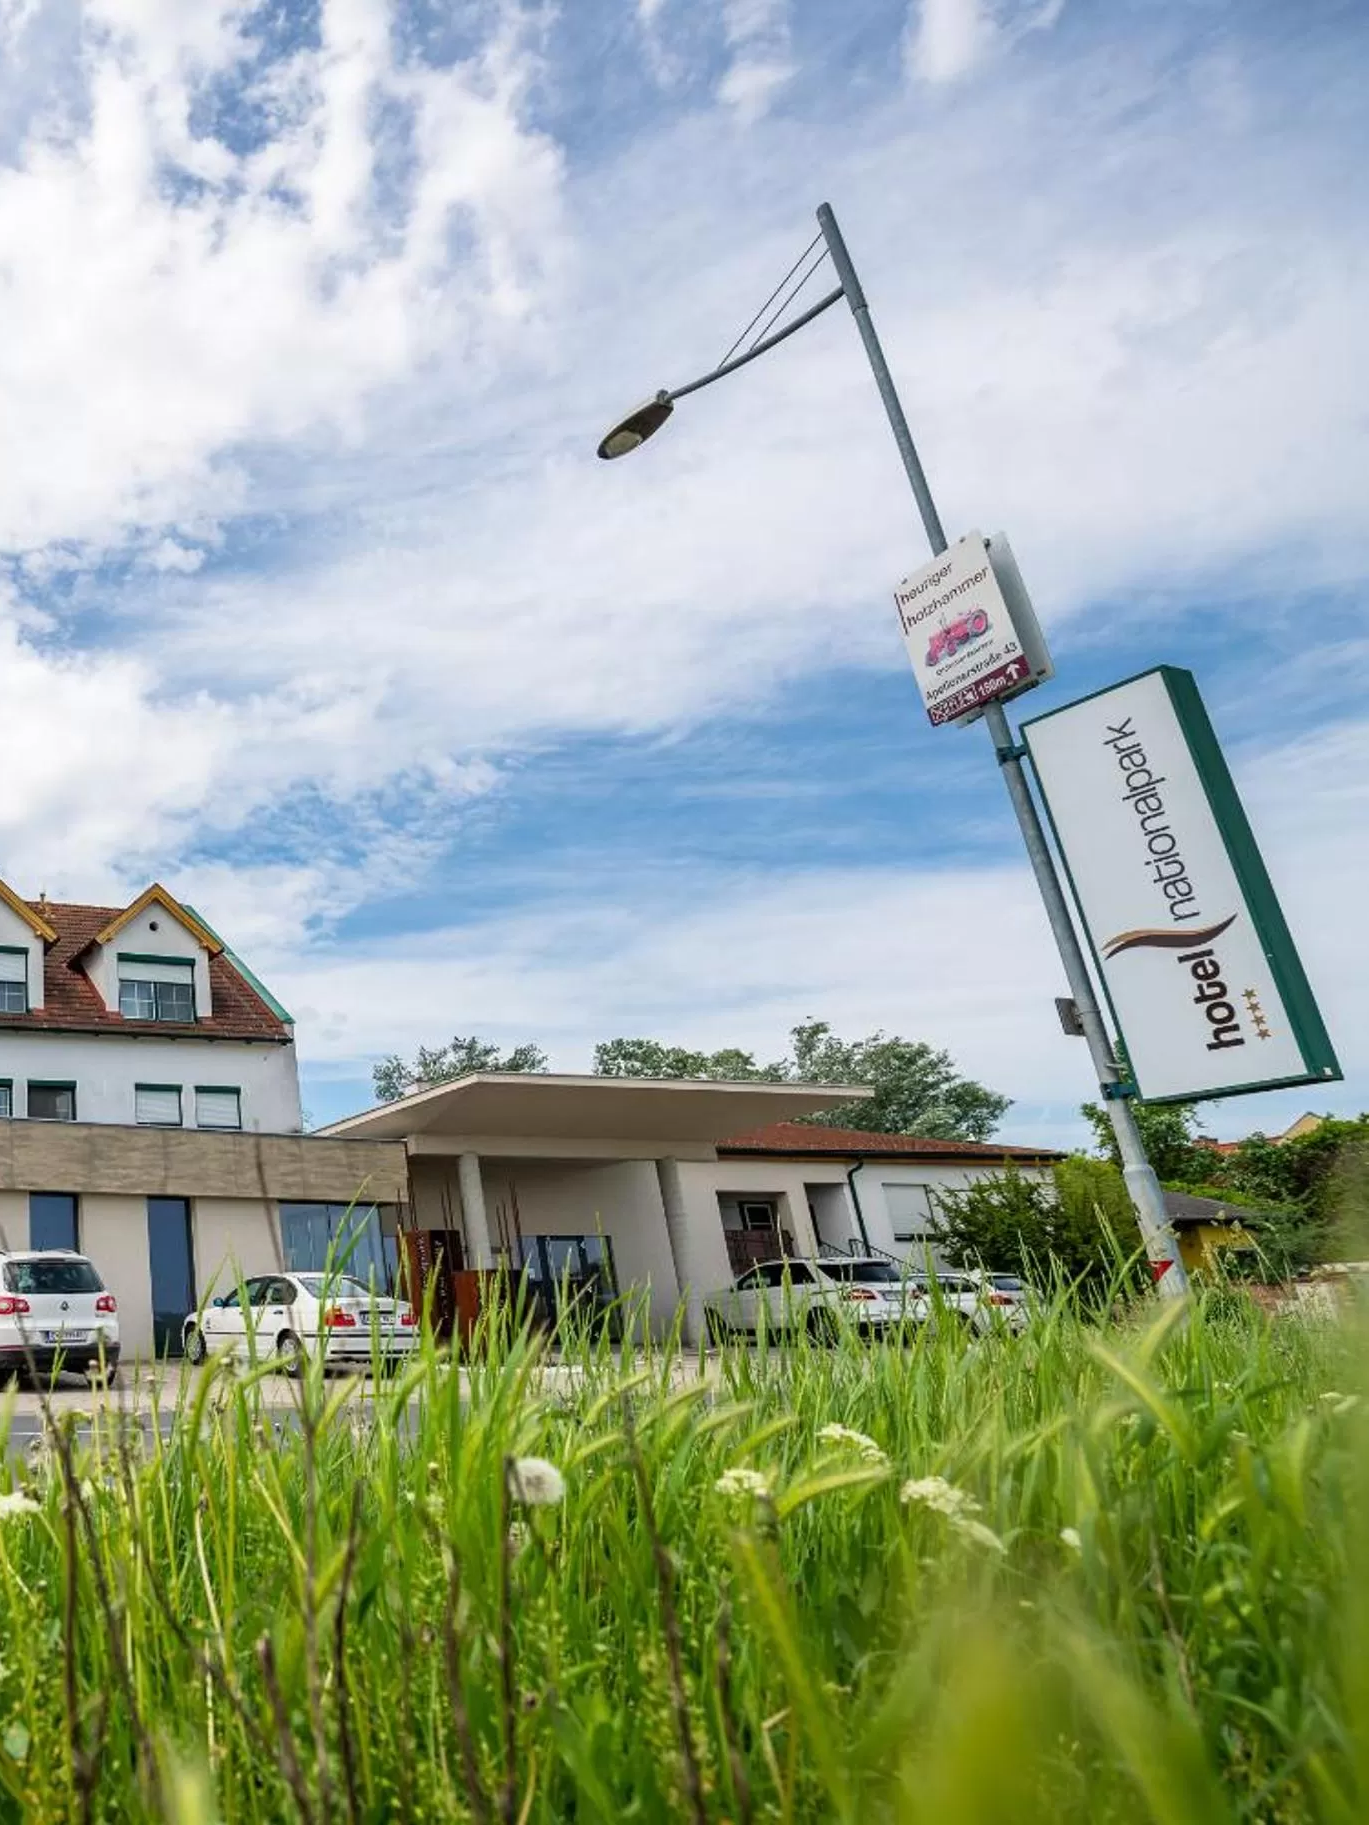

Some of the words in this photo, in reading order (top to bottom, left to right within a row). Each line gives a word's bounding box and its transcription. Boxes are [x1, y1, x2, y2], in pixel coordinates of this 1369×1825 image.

[900, 562, 952, 605] heuriger
[1103, 717, 1200, 921] nationalpark
[1177, 948, 1245, 1051] hotel
